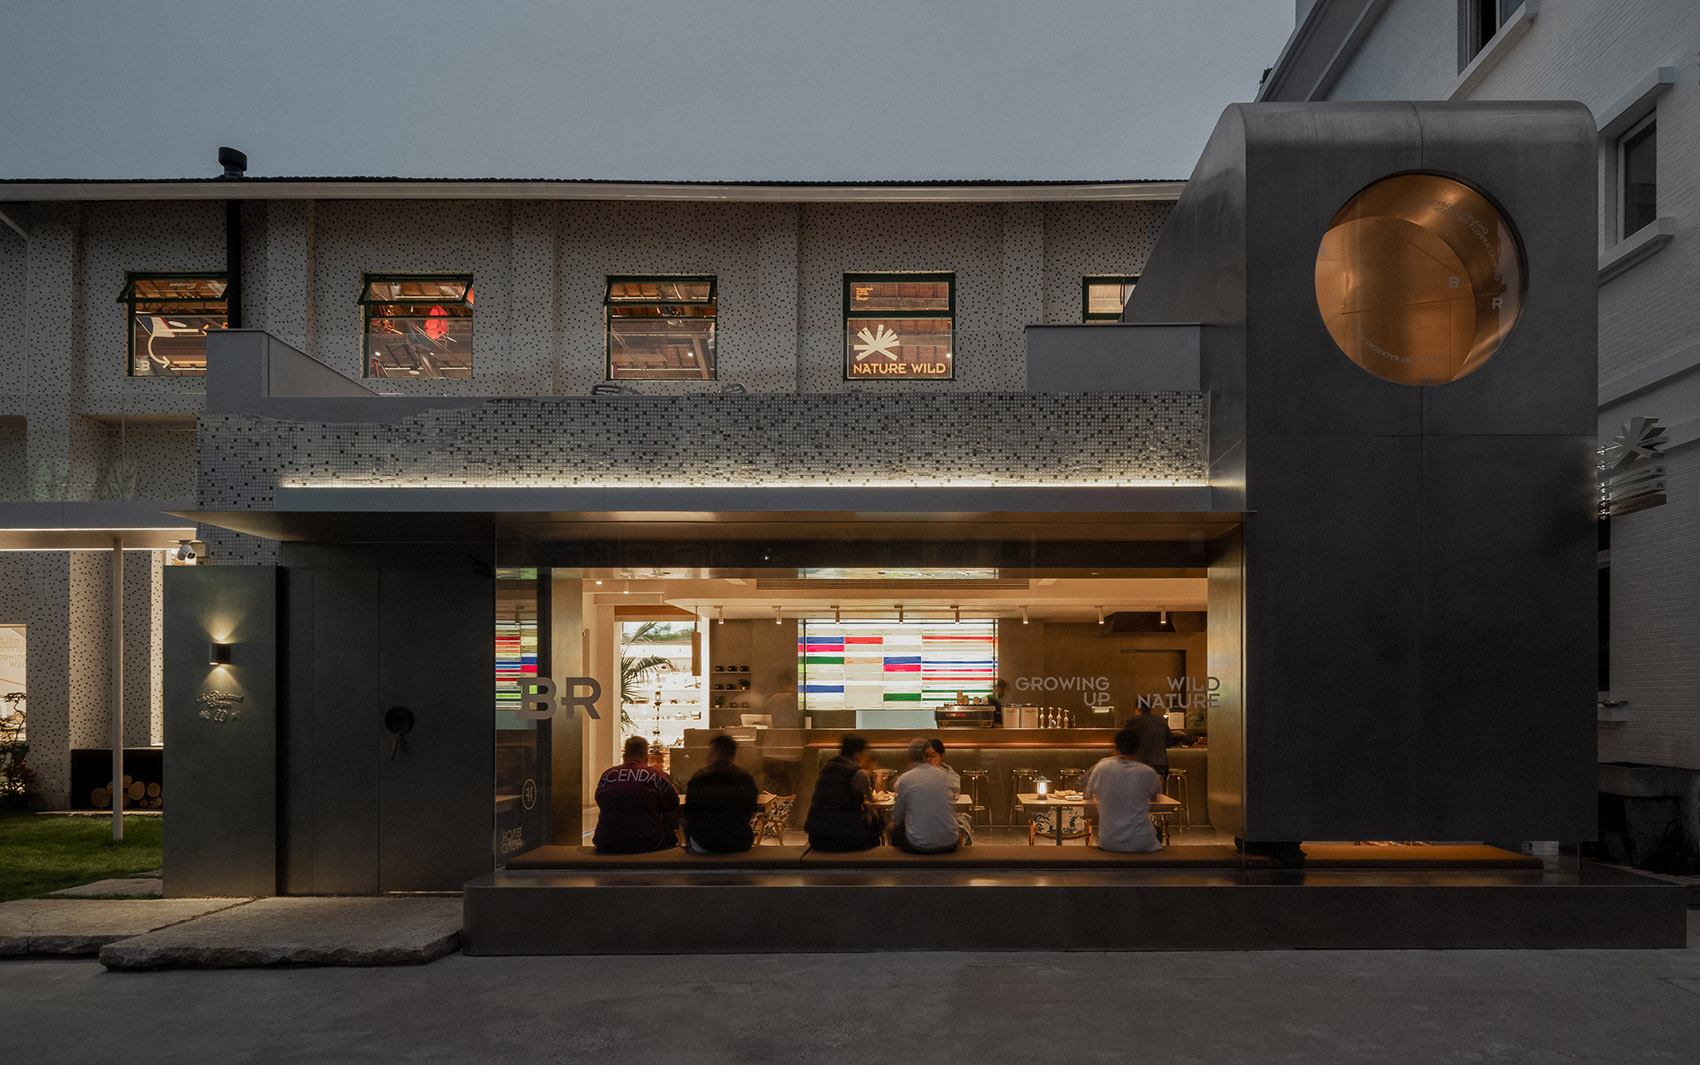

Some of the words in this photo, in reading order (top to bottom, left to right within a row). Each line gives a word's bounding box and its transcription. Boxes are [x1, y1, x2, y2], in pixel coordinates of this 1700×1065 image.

[853, 363, 907, 374] NATURE
[911, 363, 946, 374] WILD
[1015, 676, 1110, 691] GROWING
[1165, 676, 1221, 692] WILD
[517, 677, 602, 720] BR
[1083, 692, 1110, 706] UP
[1137, 692, 1221, 709] NATURE
